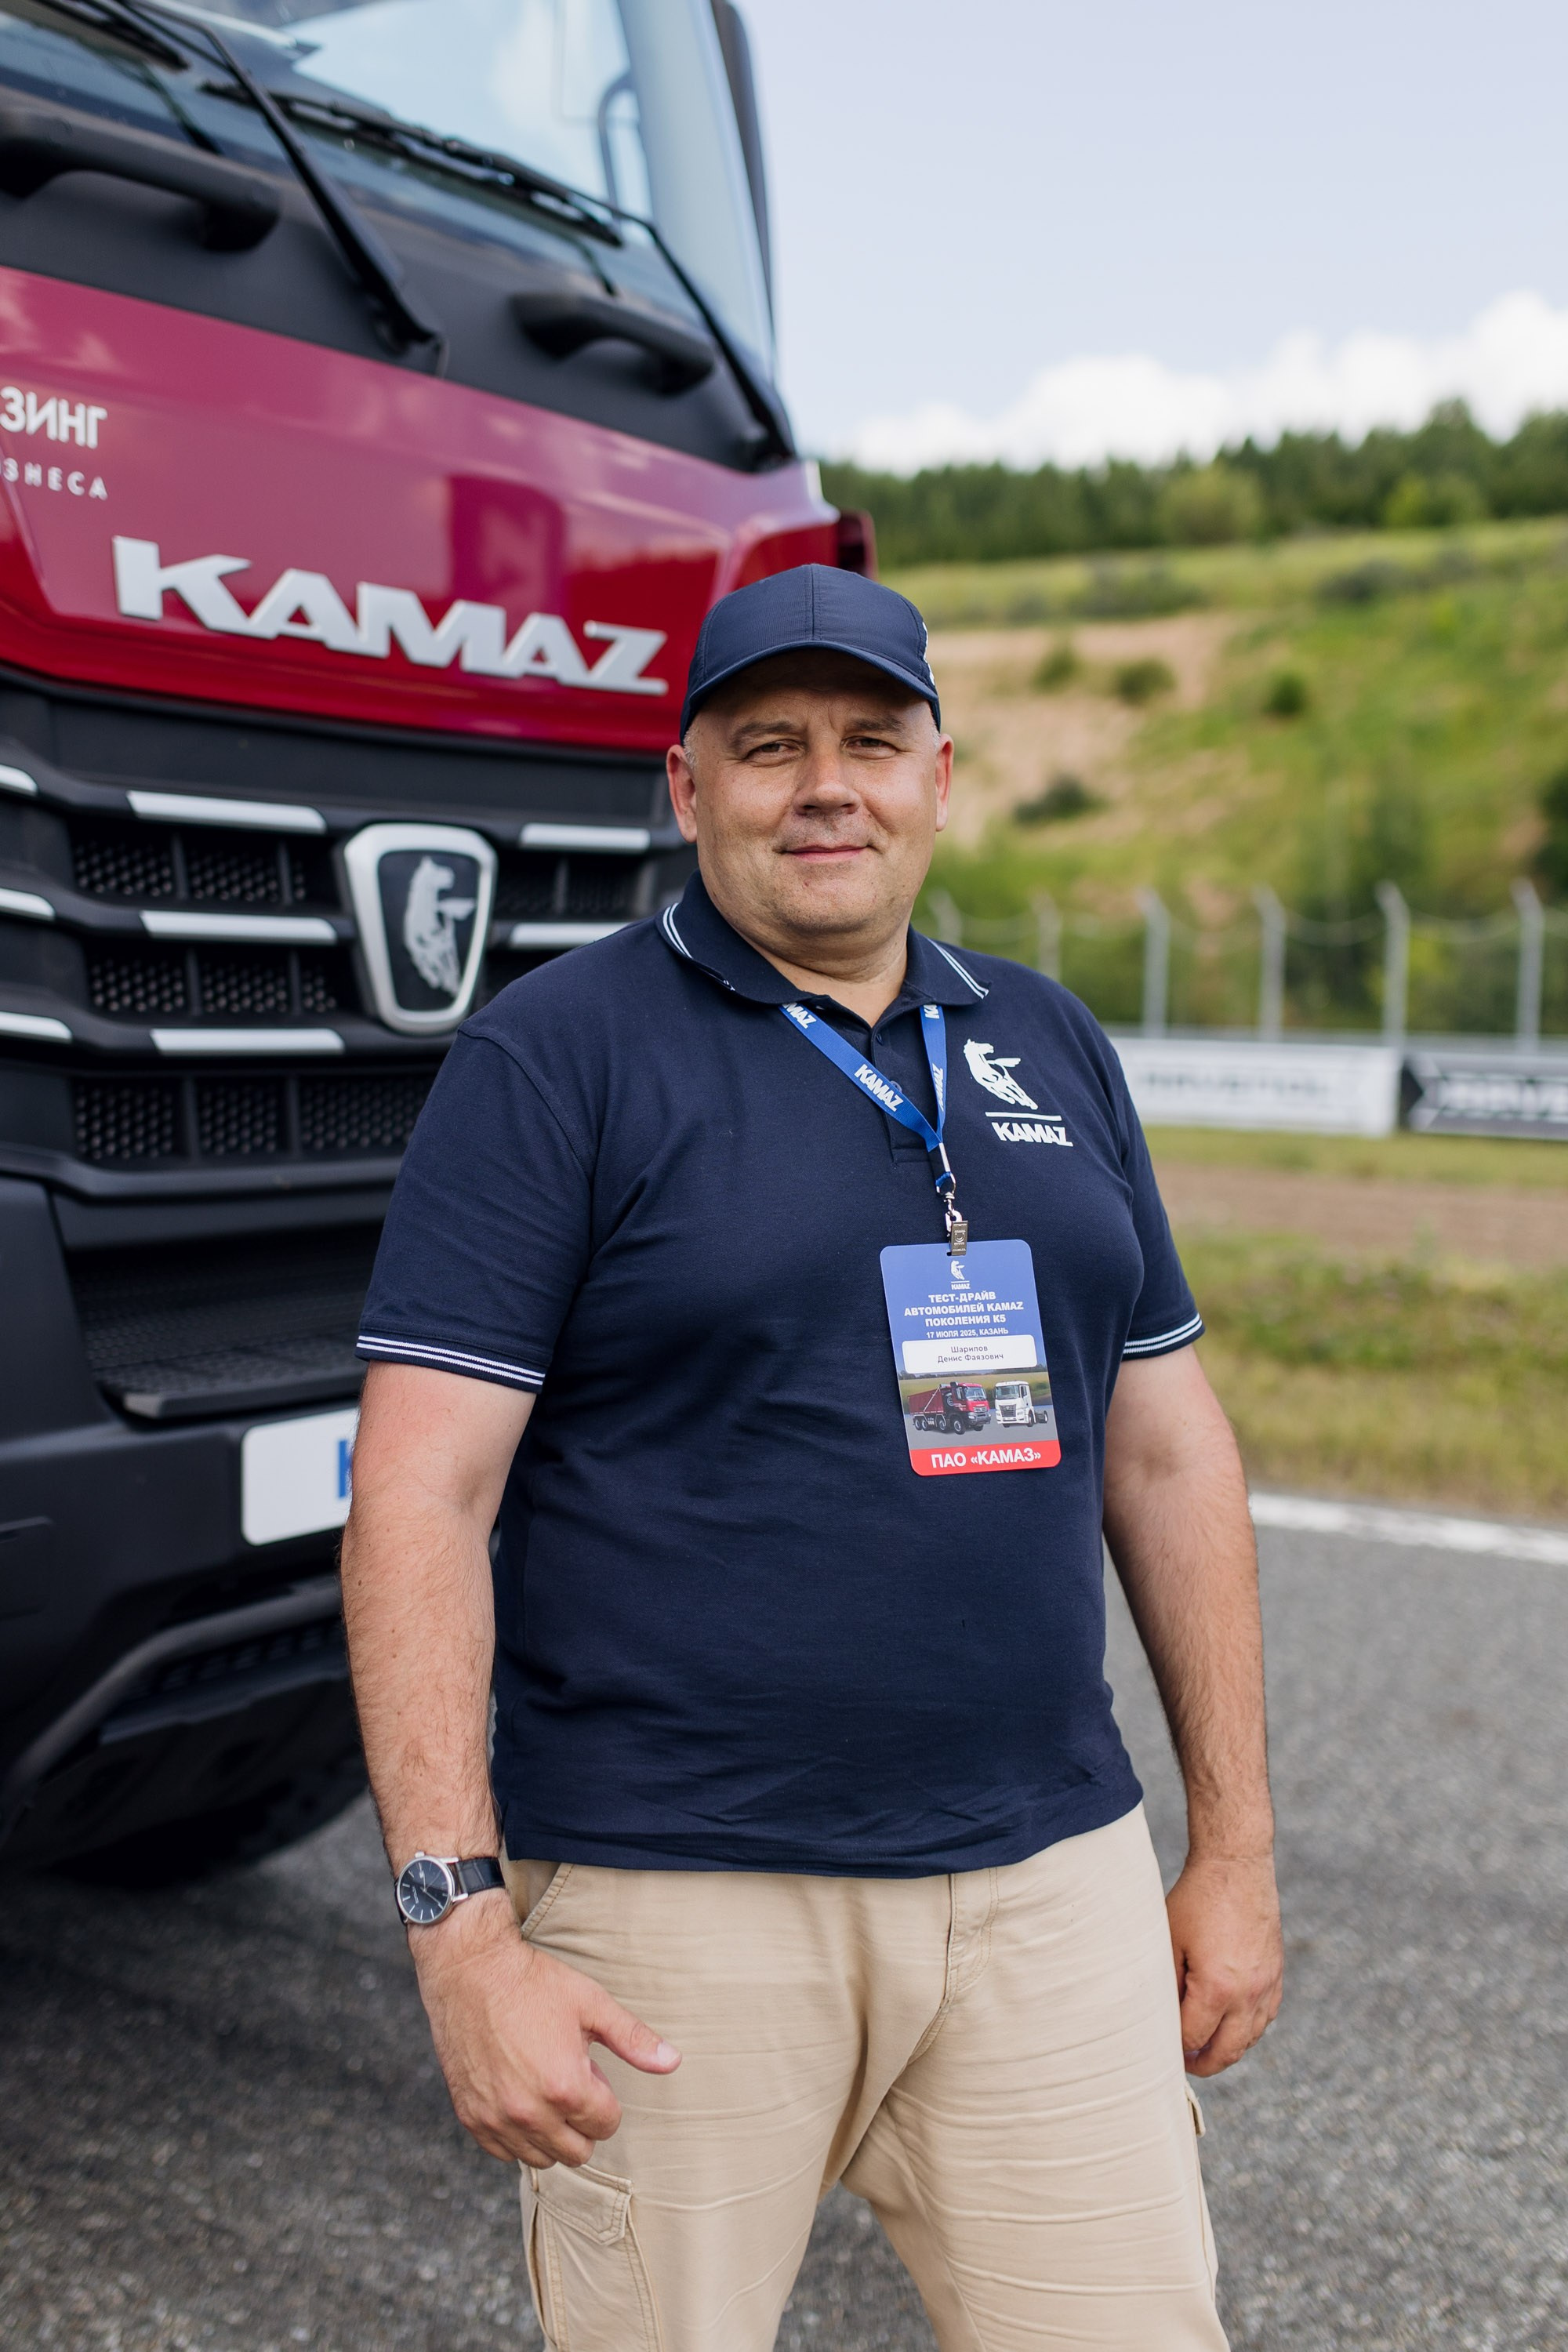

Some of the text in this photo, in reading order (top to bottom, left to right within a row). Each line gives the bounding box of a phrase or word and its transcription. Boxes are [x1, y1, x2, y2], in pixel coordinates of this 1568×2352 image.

[0, 386, 108, 449] ЗИНГ
[0, 457, 108, 501] ЗНЕСА
[112, 535, 669, 696] KAMAZ
[782, 1003, 817, 1029] MAZ
[855, 1064, 904, 1112] KAMAZ
[991, 1122, 1074, 1147] KAMAZ
[928, 1290, 996, 1303] ТЕСТ-ДРАЙВ
[904, 1301, 1024, 1316] АВТОМОБИЛЕЙ KAMAZ
[925, 1316, 990, 1327] ПОКОЛЕНИЯ
[935, 1330, 959, 1338] ИЮЛЯ
[960, 1329, 978, 1338] 2025,
[980, 1327, 1008, 1336] КАЗАНЬ
[951, 1345, 988, 1354] Шарипов
[964, 1353, 1004, 1363] Фаязович
[931, 1447, 1042, 1469] ПАО «КАМАЗ»
